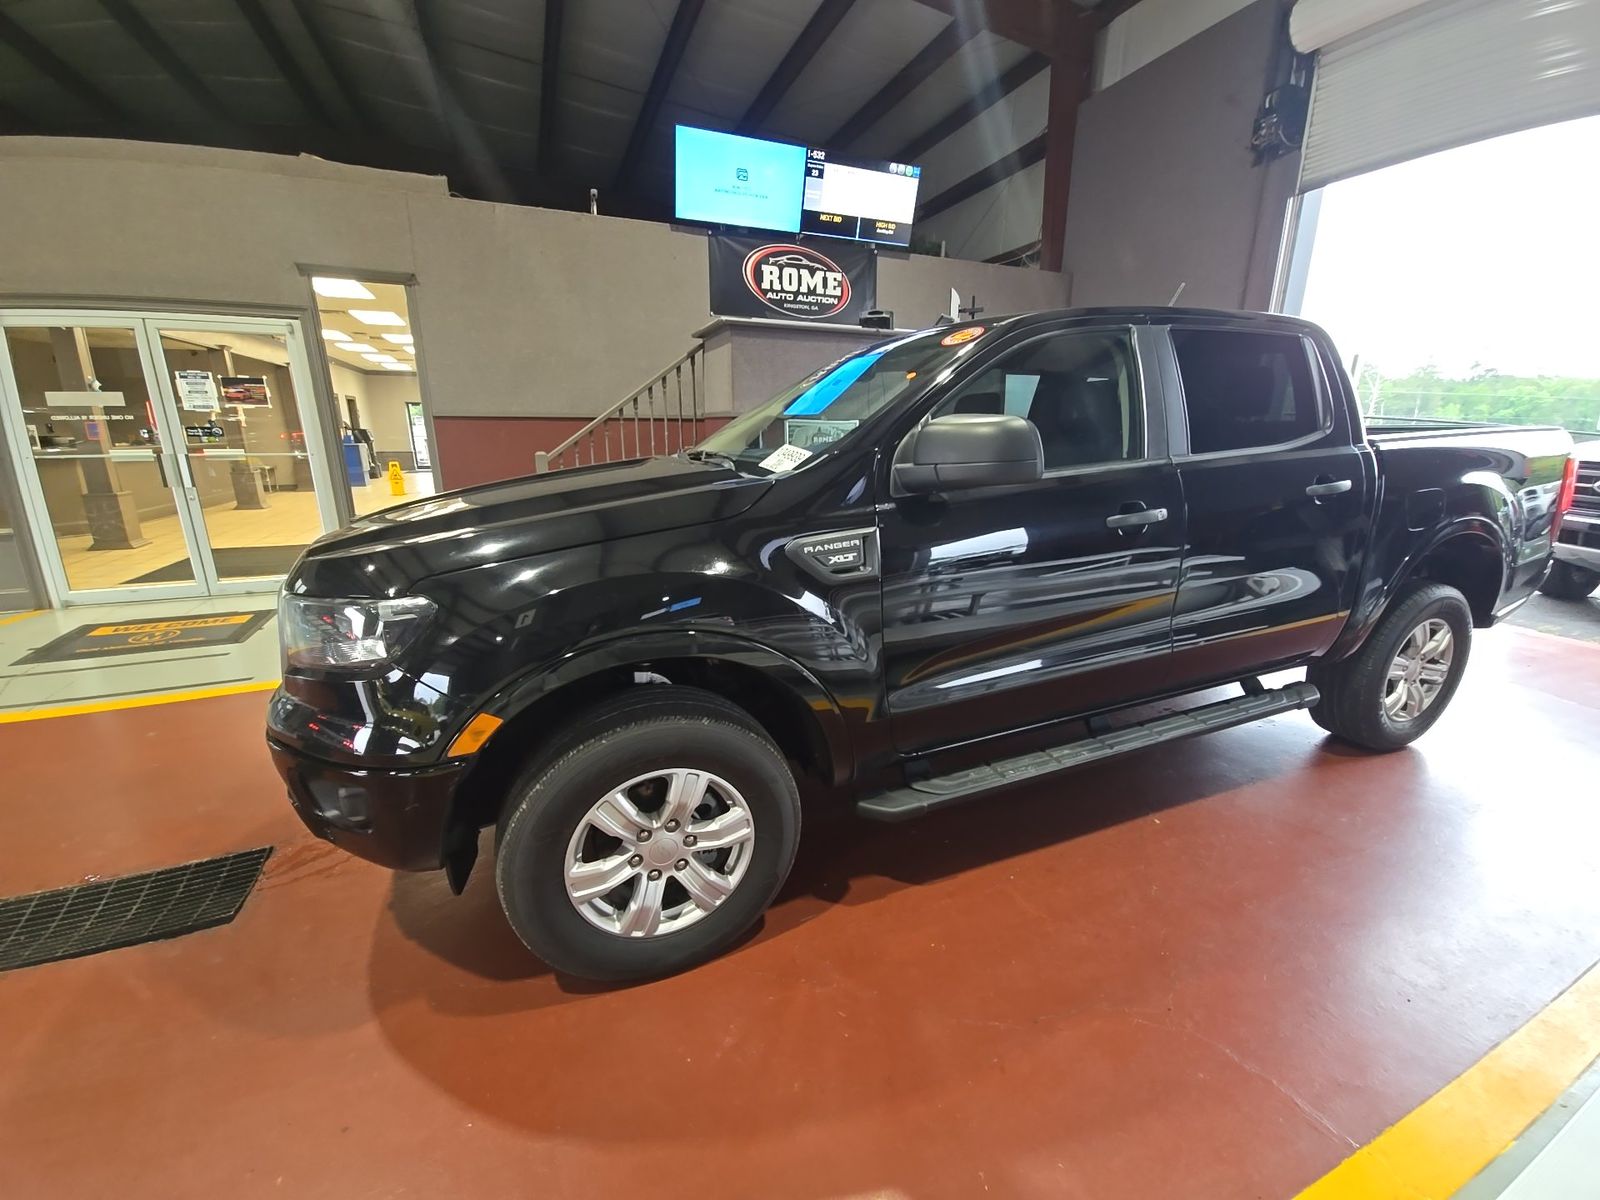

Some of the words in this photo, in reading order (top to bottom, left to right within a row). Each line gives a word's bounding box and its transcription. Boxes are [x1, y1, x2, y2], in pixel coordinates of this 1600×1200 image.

[820, 214, 833, 222] NEXT
[833, 215, 842, 223] BID
[876, 221, 887, 229] HIGH
[888, 222, 896, 230] BID
[761, 264, 842, 296] ROME
[766, 291, 794, 301] AUTO
[796, 294, 838, 305] AUCTION
[803, 539, 860, 554] RANGER
[828, 552, 857, 564] XLT
[112, 617, 231, 633] WELCOME
